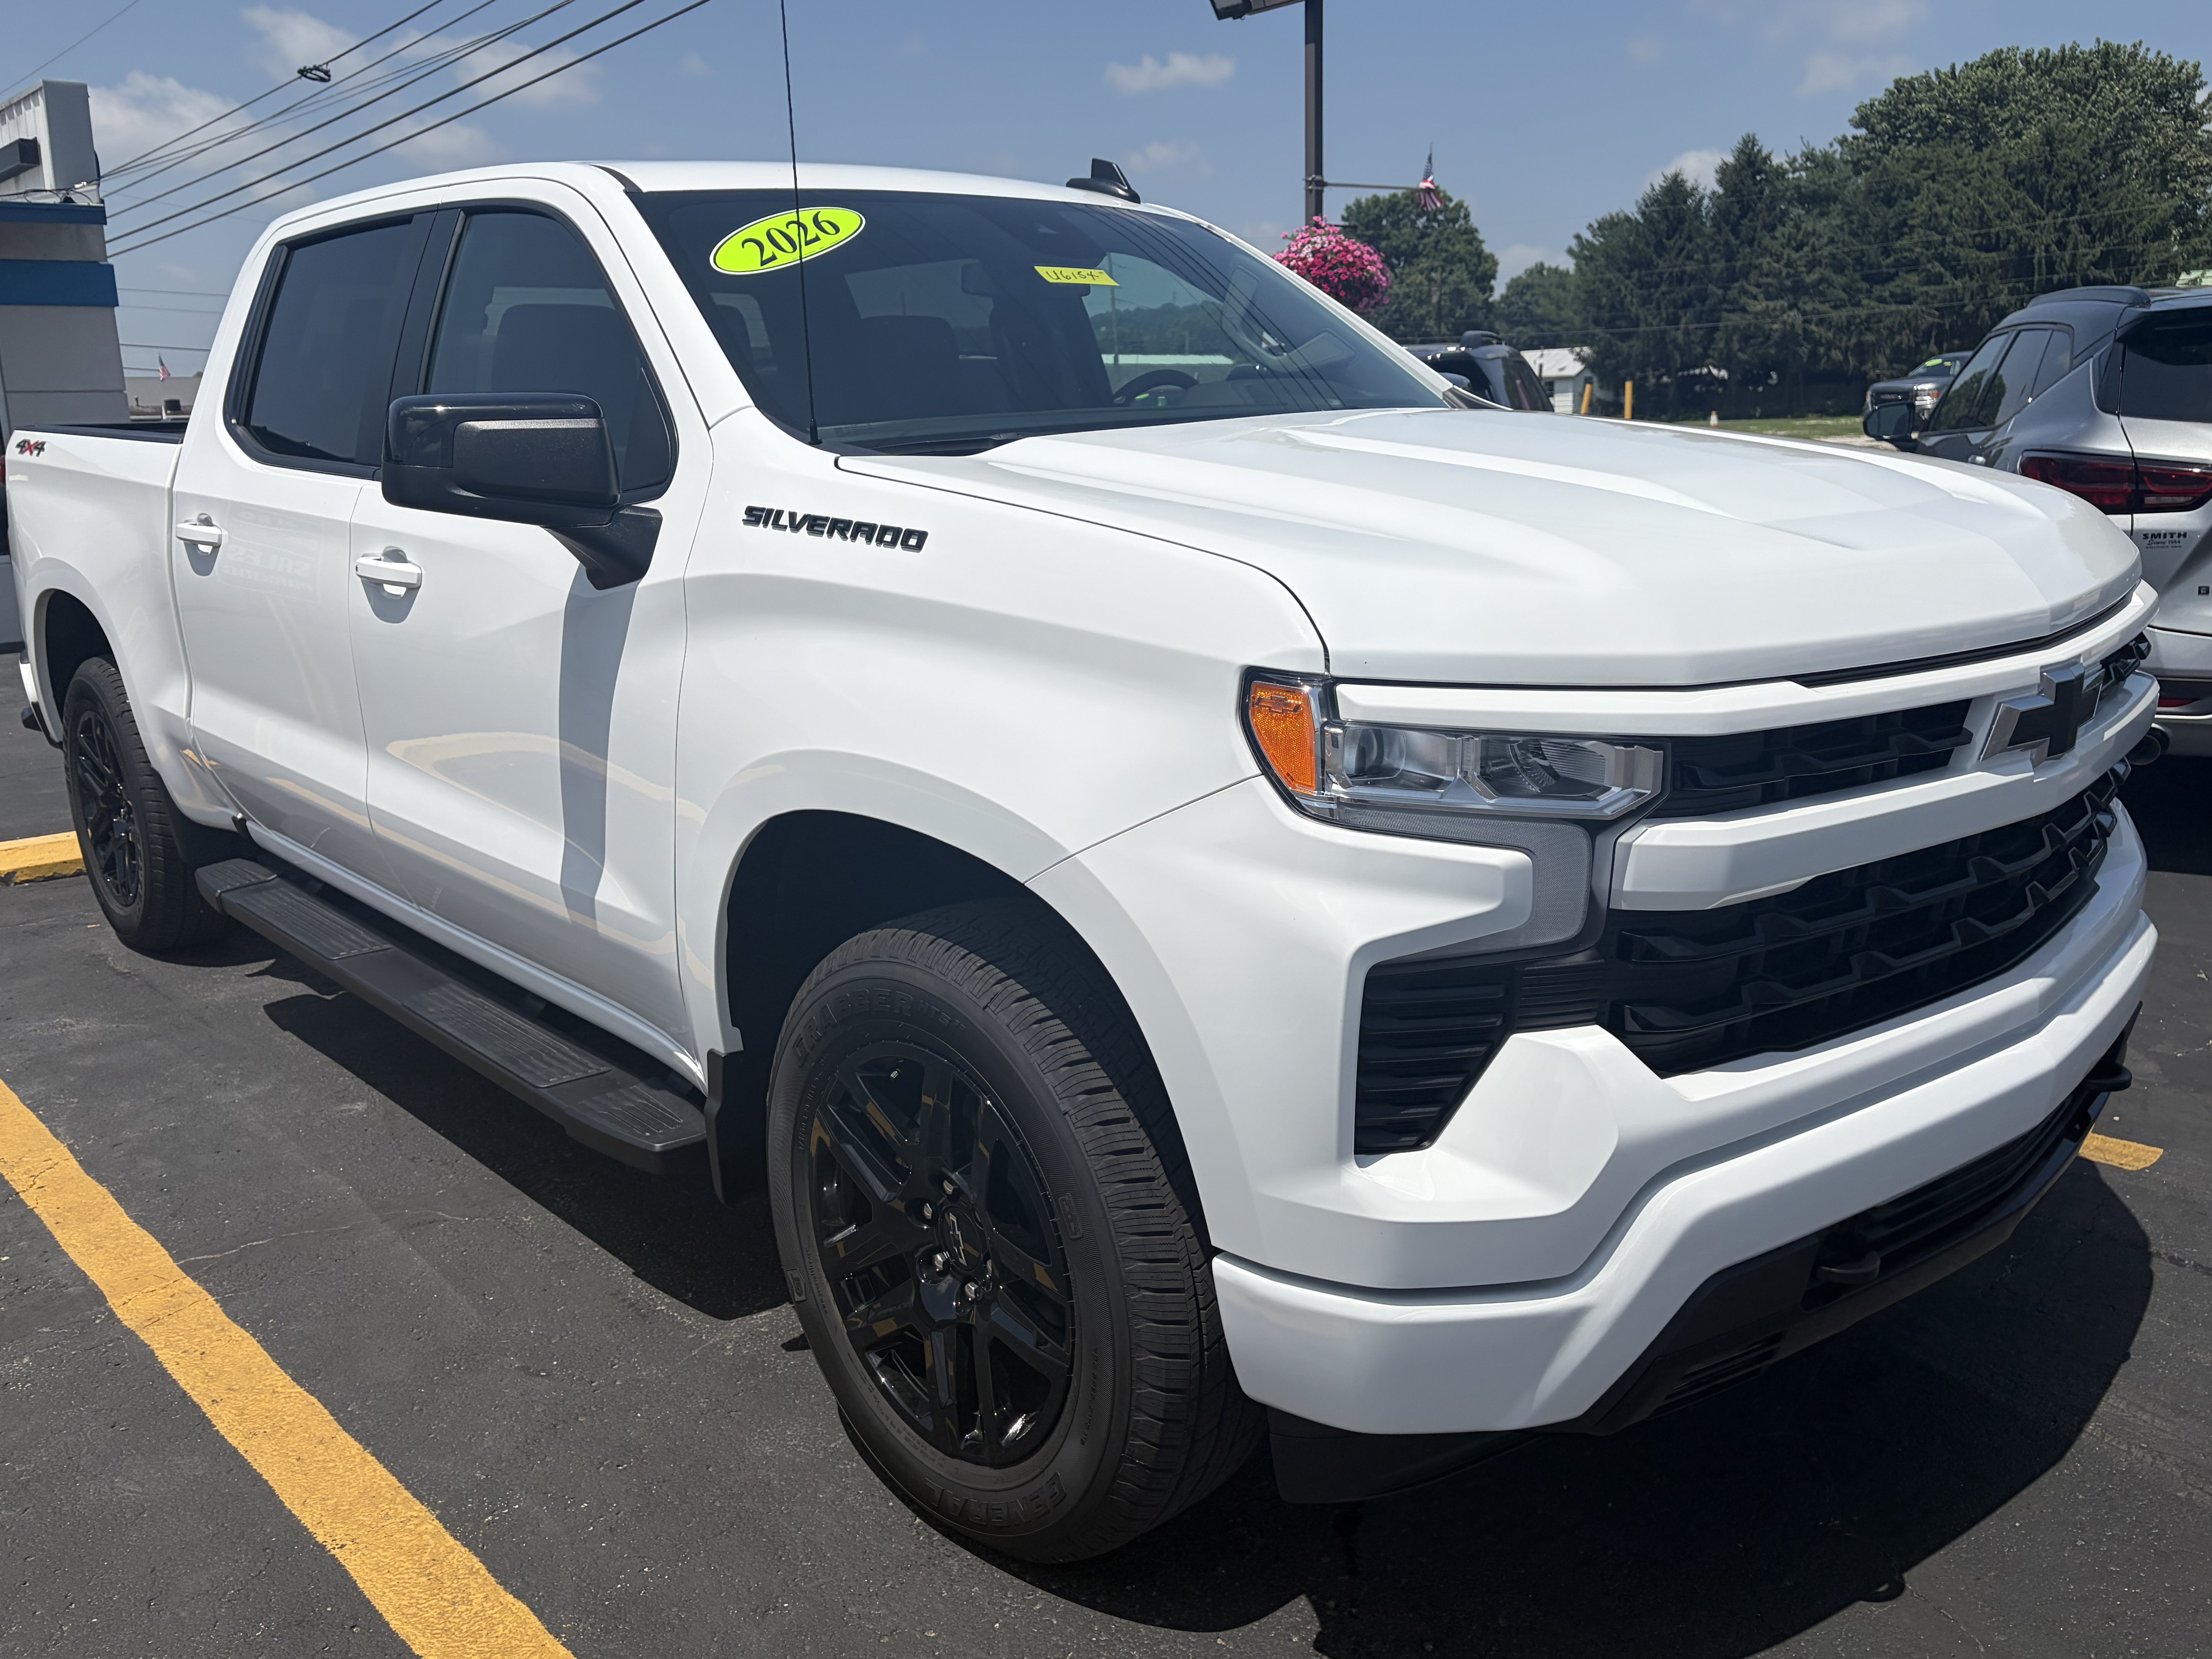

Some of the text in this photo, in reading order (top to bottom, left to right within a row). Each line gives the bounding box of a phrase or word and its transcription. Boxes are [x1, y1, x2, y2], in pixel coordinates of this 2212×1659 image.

[742, 211, 840, 266] 2026
[742, 505, 929, 553] SILVERADO
[792, 988, 913, 1068] GRABBER
[923, 1471, 1067, 1527] GENERAL
